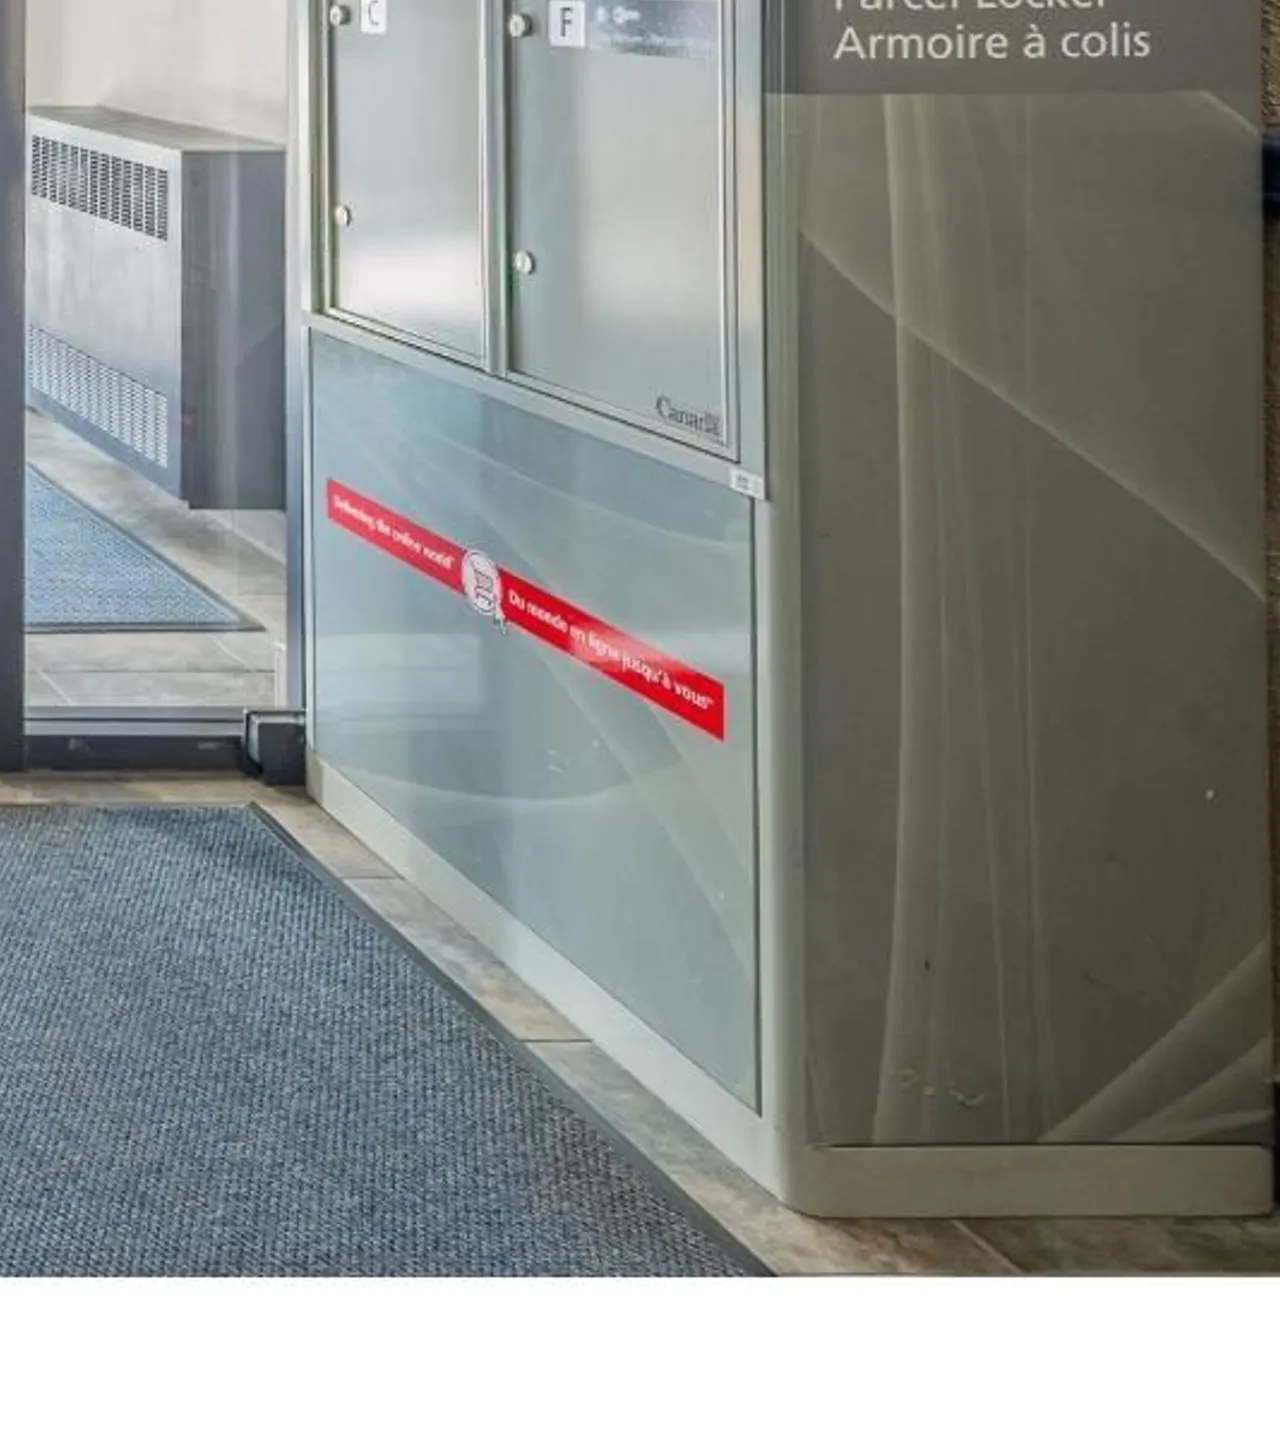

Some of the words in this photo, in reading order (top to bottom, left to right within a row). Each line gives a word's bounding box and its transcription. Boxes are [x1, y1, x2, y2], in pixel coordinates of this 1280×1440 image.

[367, 0, 379, 26] C
[560, 6, 572, 37] F
[833, 23, 1009, 60] Armoire
[1023, 24, 1046, 59] à
[1060, 21, 1151, 58] colis
[508, 588, 526, 610] Du
[569, 624, 586, 644] en
